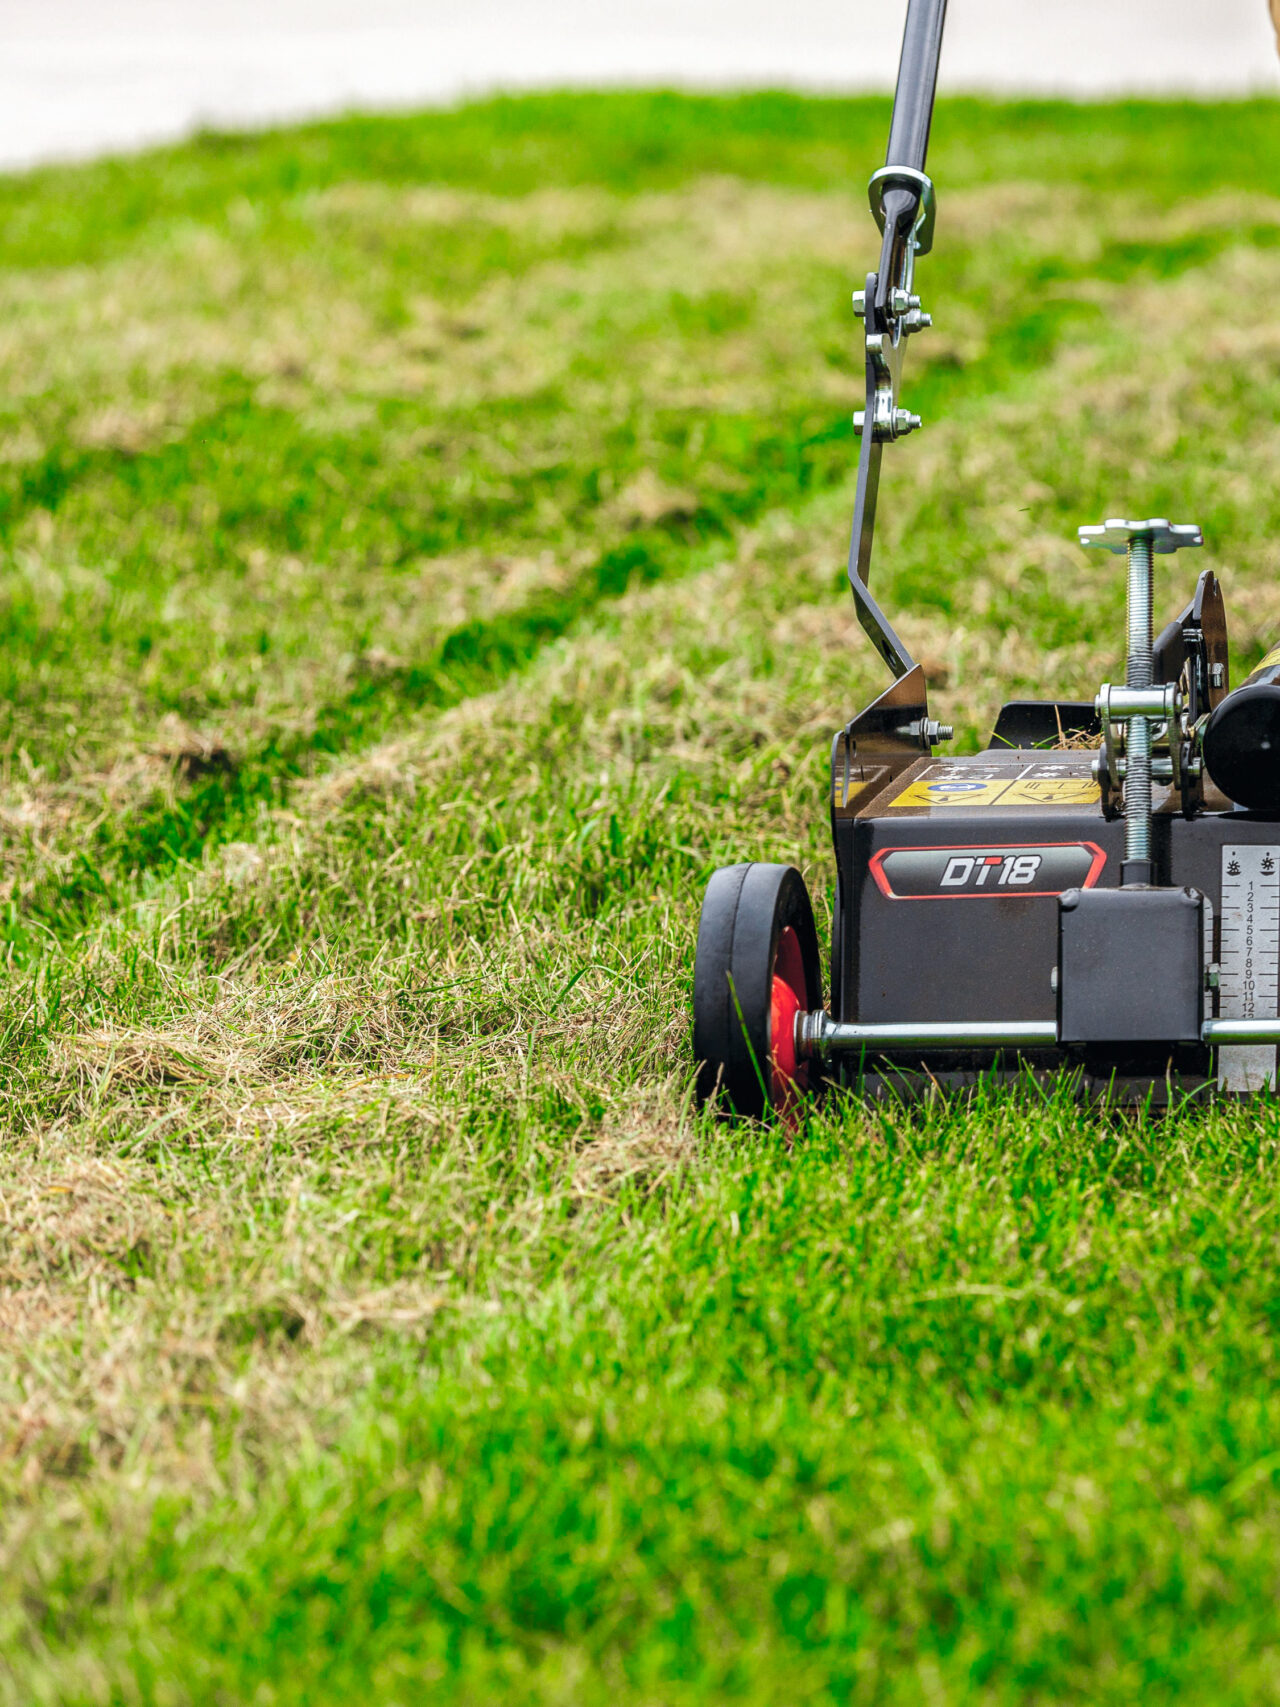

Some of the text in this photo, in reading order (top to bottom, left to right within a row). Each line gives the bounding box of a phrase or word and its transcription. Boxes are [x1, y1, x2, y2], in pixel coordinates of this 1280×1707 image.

[940, 855, 1042, 886] DT18
[1249, 881, 1253, 890] 1
[1247, 892, 1254, 901] 2
[1247, 903, 1254, 912] 3
[1247, 914, 1253, 923] 4
[1246, 925, 1253, 935] 5
[1246, 936, 1253, 946] 6
[1246, 947, 1253, 957] 7
[1245, 958, 1253, 968] 8
[1245, 969, 1252, 979] 9
[1243, 980, 1255, 991] 10
[1243, 992, 1254, 1001] 11
[1242, 1003, 1255, 1013] 12
